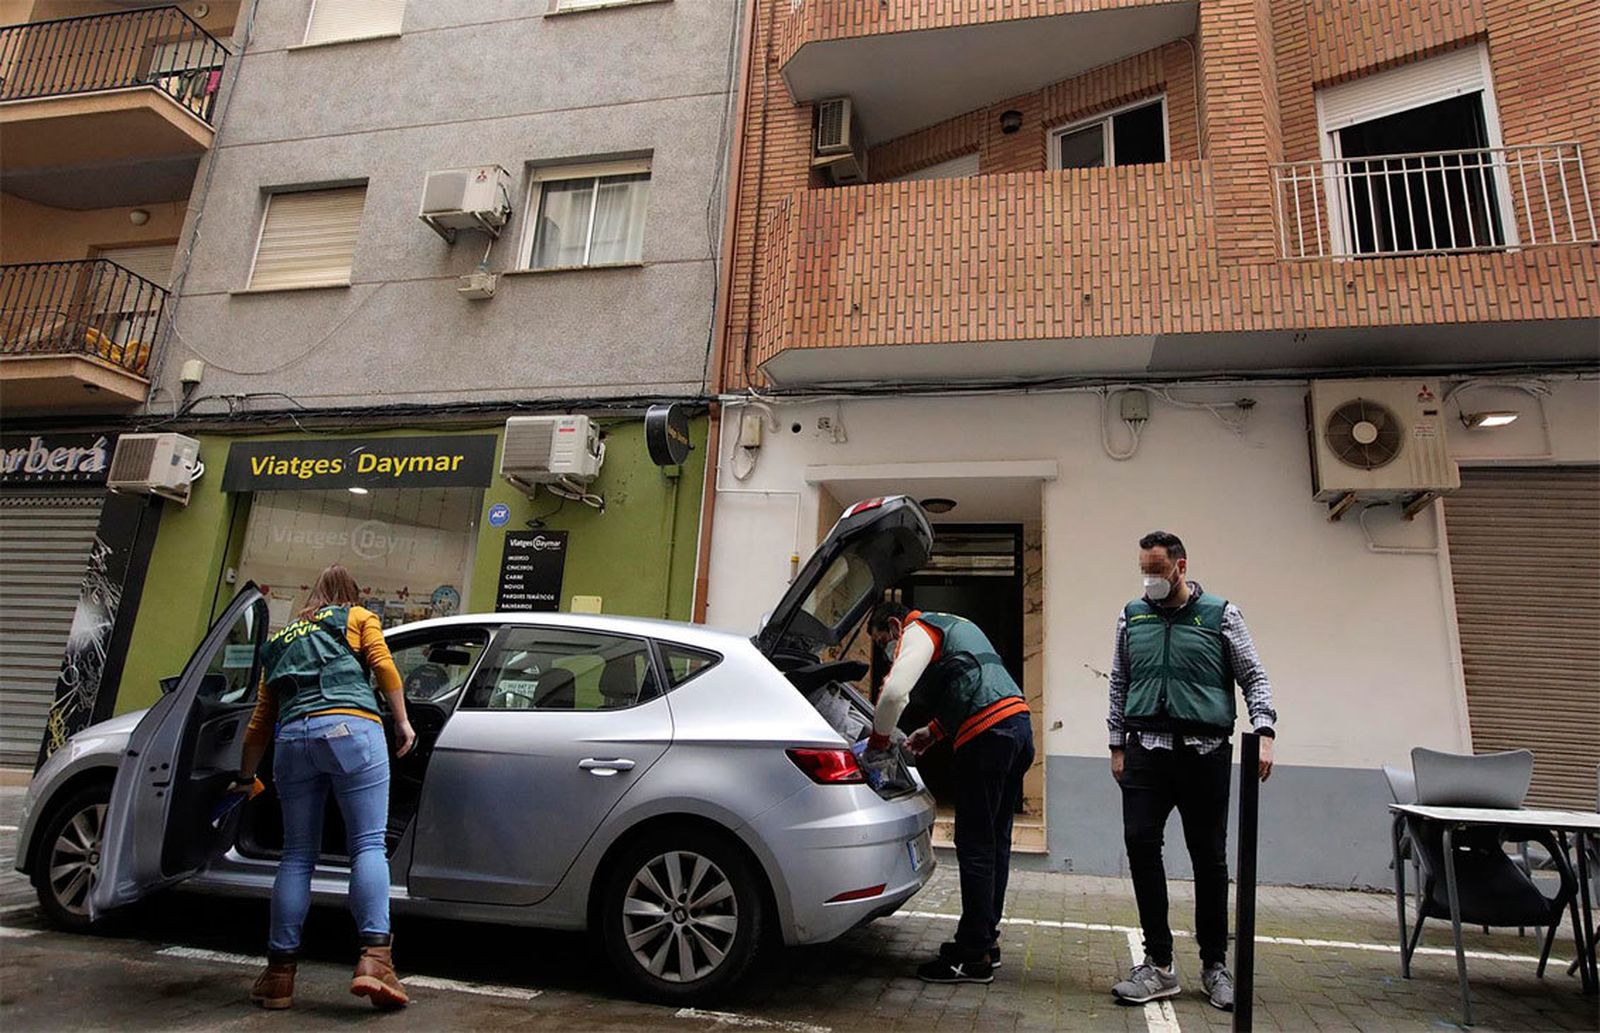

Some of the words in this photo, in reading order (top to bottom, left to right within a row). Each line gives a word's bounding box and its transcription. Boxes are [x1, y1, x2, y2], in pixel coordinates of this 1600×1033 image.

[250, 456, 343, 480] Viatges
[357, 453, 465, 477] Daymar
[272, 525, 348, 549] Viatges
[510, 539, 533, 548] Viatges
[535, 539, 561, 548] Daymar
[271, 609, 333, 642] UARIA
[284, 624, 320, 643] CIVIL
